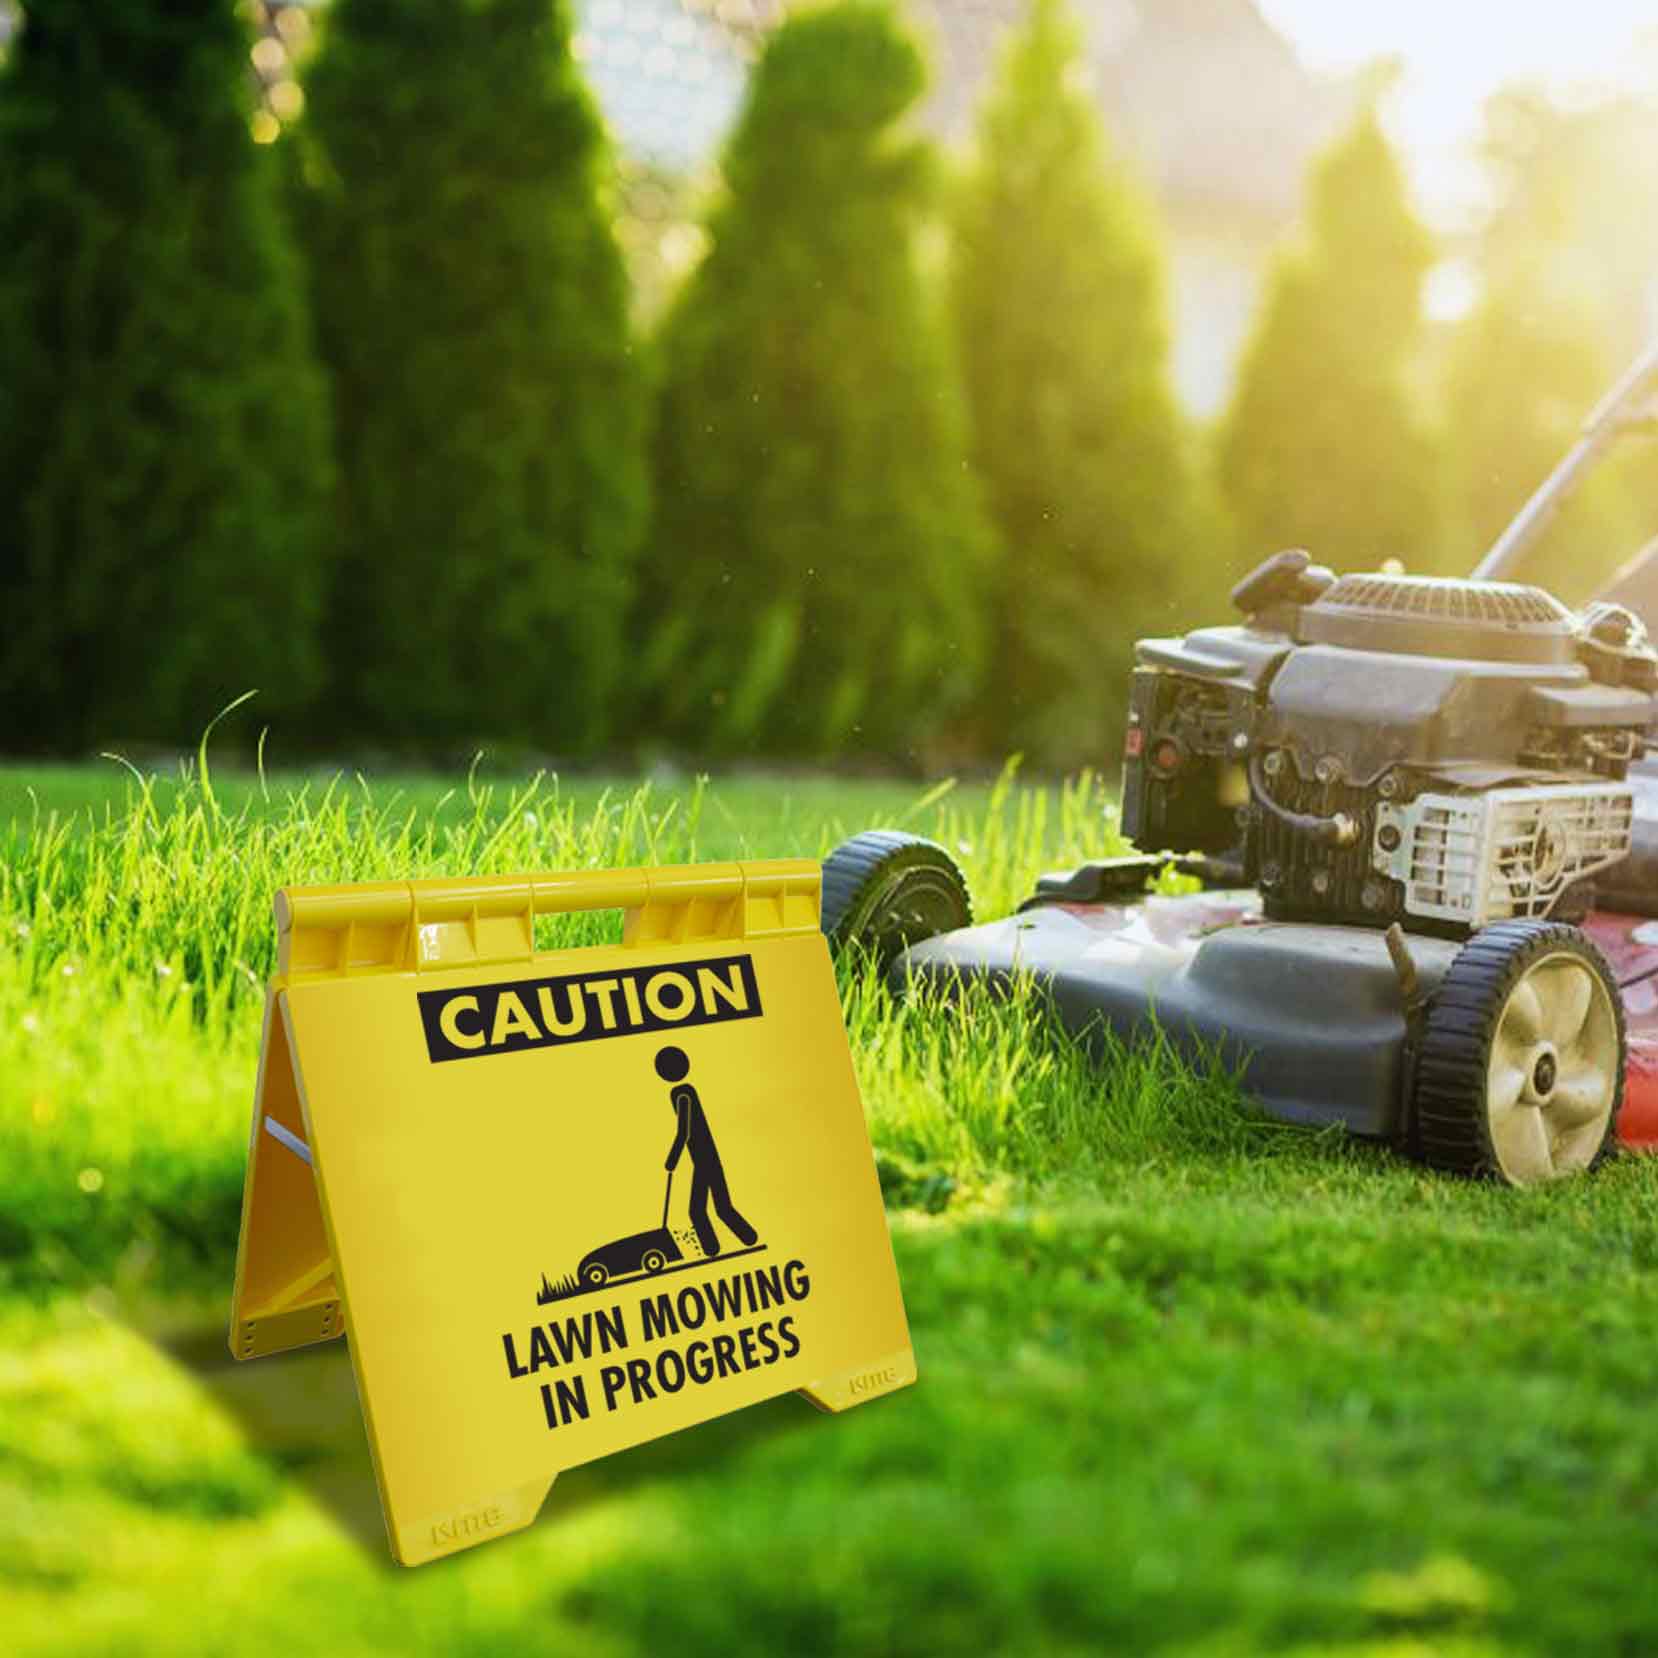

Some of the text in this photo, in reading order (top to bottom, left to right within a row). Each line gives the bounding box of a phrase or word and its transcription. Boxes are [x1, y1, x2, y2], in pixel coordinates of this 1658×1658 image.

[440, 965, 748, 1049] CAUTION
[503, 1260, 809, 1378] LAWN MOWING
[541, 1317, 800, 1429] IN PROGRESS
